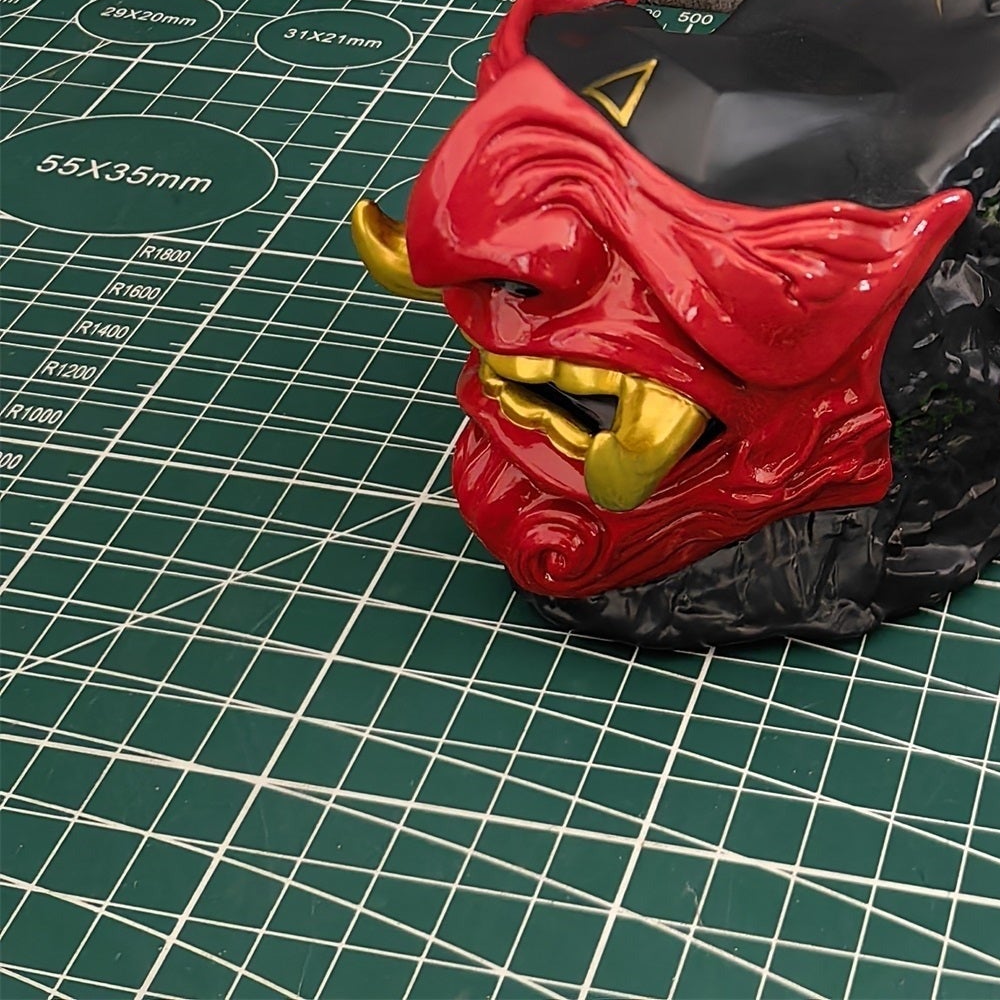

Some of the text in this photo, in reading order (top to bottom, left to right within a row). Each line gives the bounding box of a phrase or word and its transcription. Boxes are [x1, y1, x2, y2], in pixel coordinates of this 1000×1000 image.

[100, 6, 197, 27] 29X20mm
[678, 11, 714, 25] 500
[283, 28, 383, 49] 31X21mm
[36, 154, 213, 193] 55X35mm
[140, 245, 192, 263] R1800
[109, 282, 161, 300] R1600
[76, 320, 130, 340] R1400
[41, 360, 97, 381] R1200
[5, 403, 64, 425] R1000
[0, 451, 24, 470] 00
